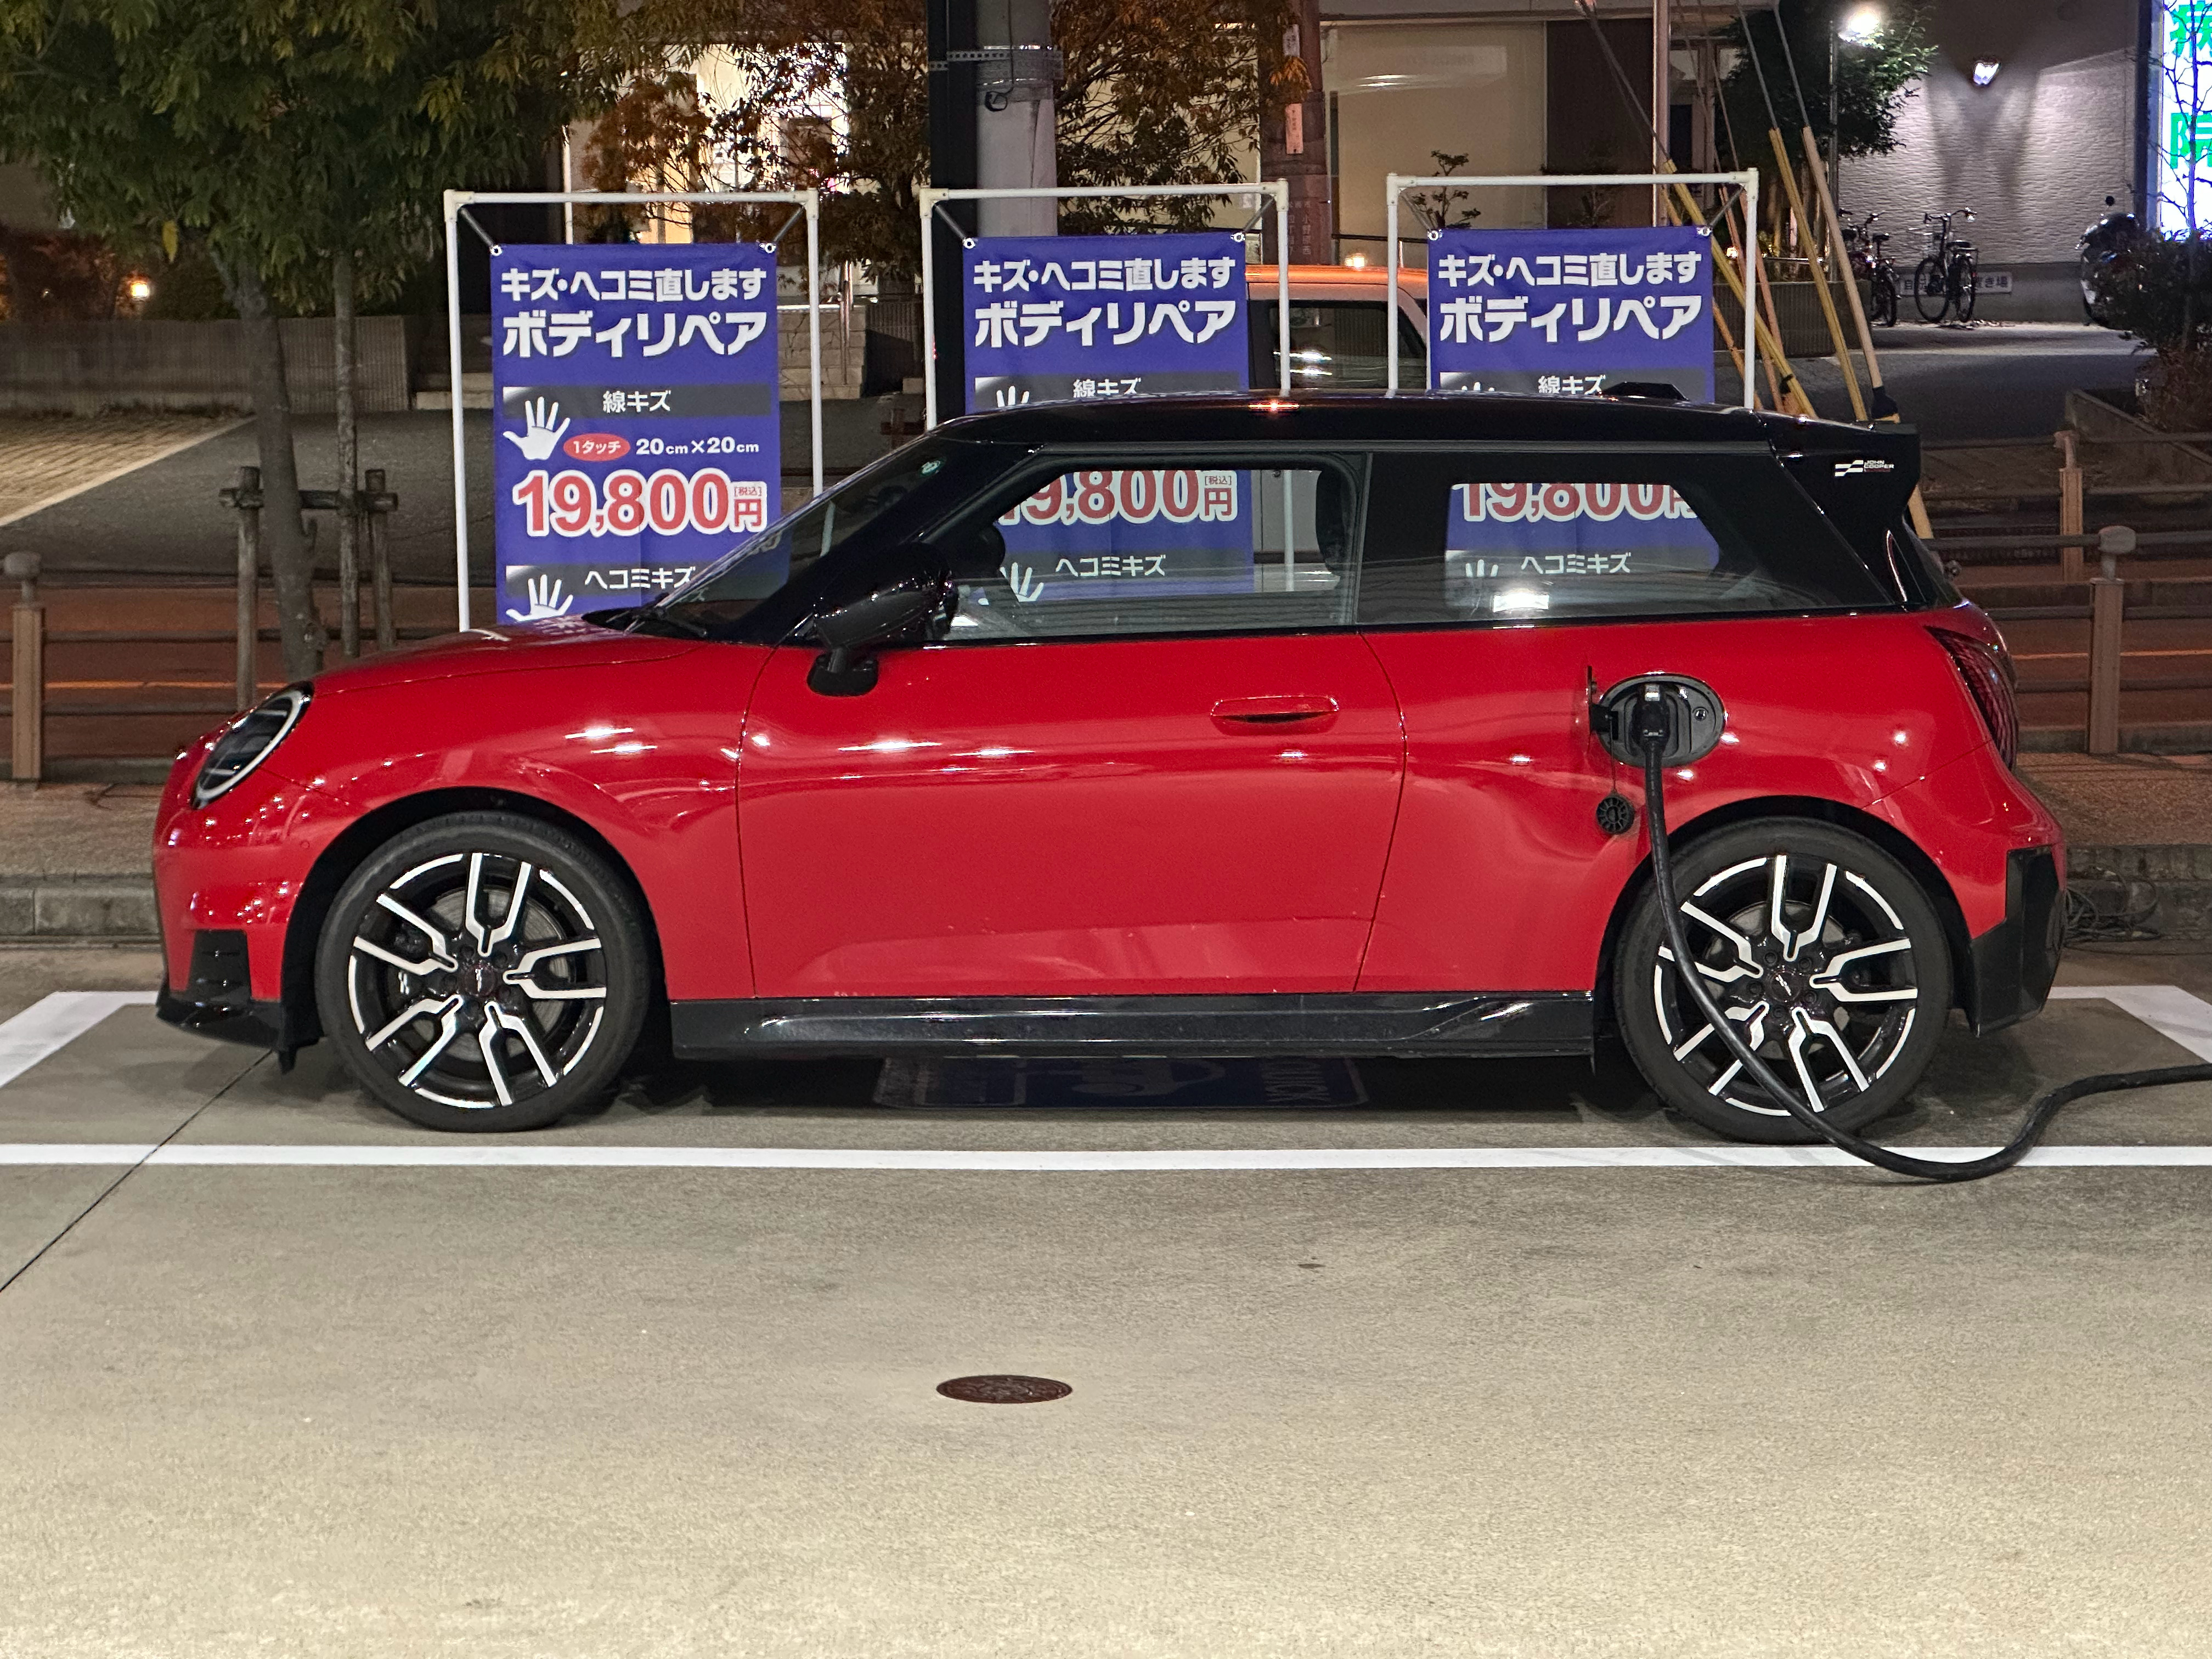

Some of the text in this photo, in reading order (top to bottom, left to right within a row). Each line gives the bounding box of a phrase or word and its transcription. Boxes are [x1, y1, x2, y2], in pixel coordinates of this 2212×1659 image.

[973, 257, 1235, 293] キズ・ヘコミ直します
[1438, 251, 1701, 287] キズ・ヘコミ直します
[501, 268, 767, 301] キズ・ヘコミ直します
[975, 300, 1236, 348] ボディリペア
[1440, 295, 1702, 343] ボディリペア
[503, 310, 768, 358] ボディリペア
[1073, 377, 1141, 398] 線キズ
[1538, 375, 1606, 395] 線キズ
[602, 390, 671, 413] 線キズ
[573, 440, 621, 455] 1タッチ
[1003, 470, 1234, 520] 9,800円
[1055, 554, 1166, 577] ヘコミキズ
[1520, 551, 1632, 574] ヘコミキズ
[585, 566, 696, 590] ヘコミキズ
